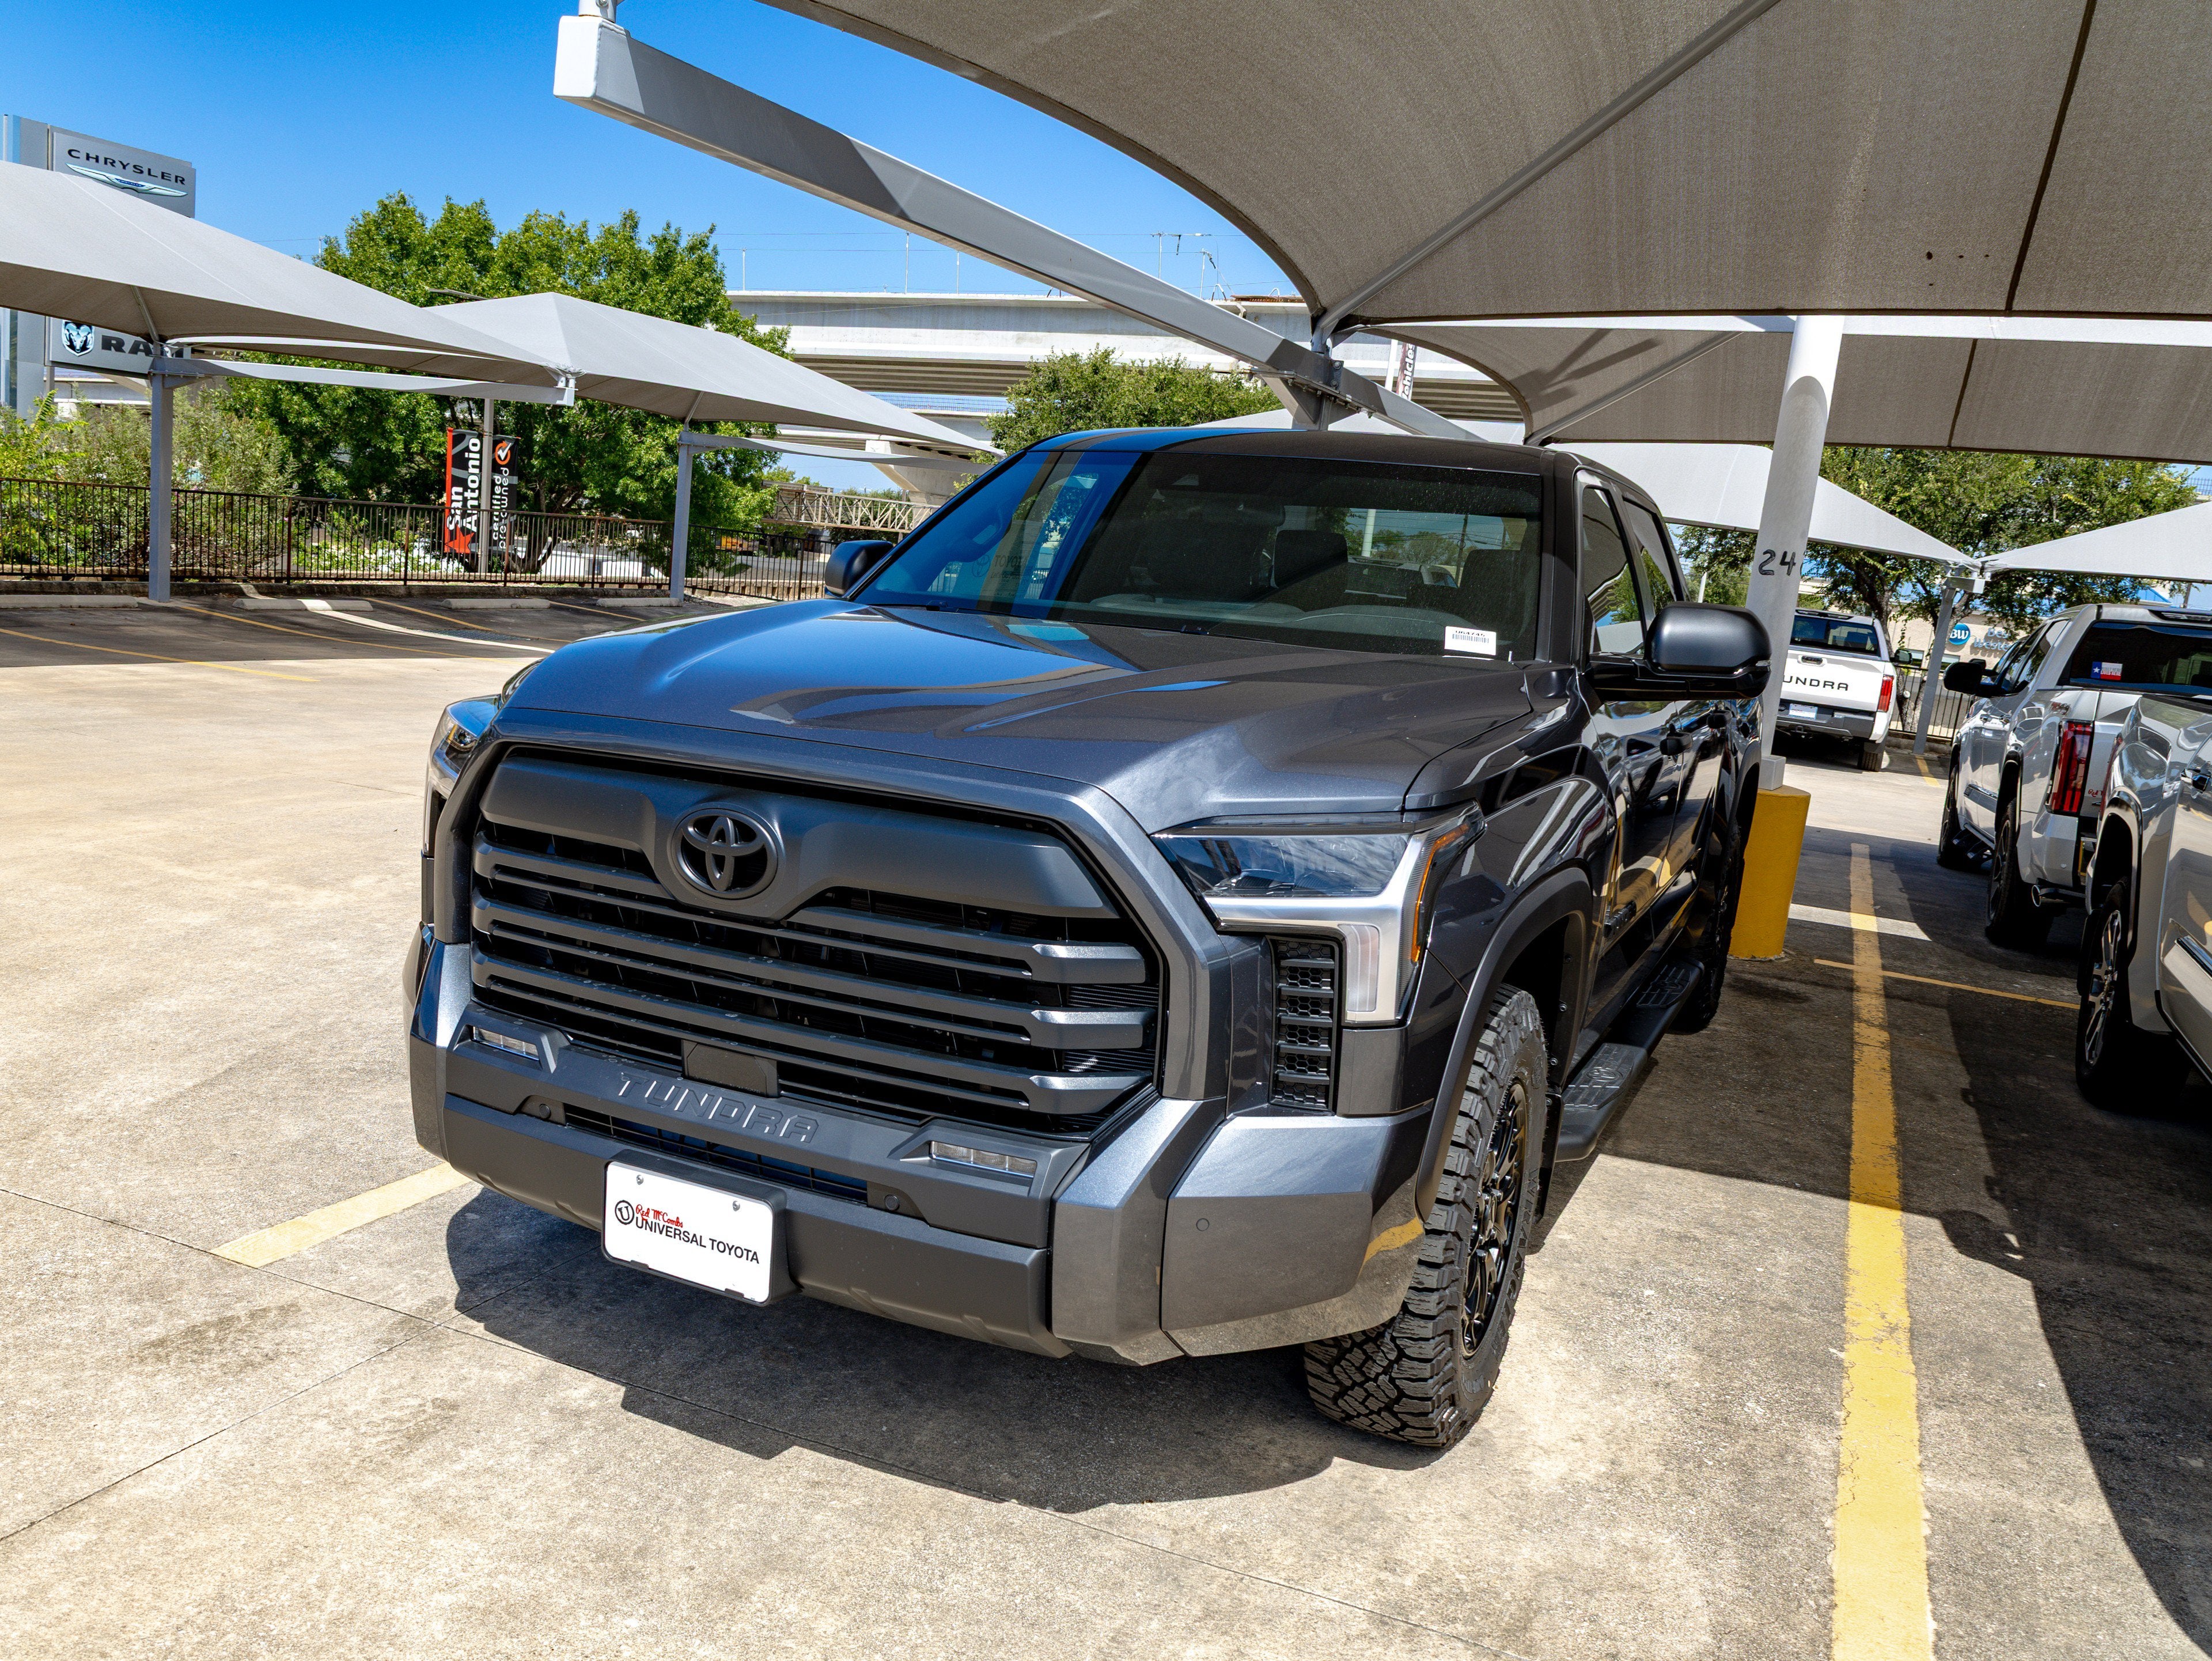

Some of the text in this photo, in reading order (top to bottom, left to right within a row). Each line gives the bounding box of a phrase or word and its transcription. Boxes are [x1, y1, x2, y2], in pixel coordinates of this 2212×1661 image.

[67, 149, 186, 186] CHRYSLER
[101, 335, 184, 358] RA
[463, 438, 480, 532] Antonio
[446, 487, 463, 530] San
[492, 475, 502, 540] certified
[499, 467, 509, 549] pre-owned
[1758, 549, 1806, 576] 24
[1950, 629, 1969, 640] BW
[1974, 637, 2010, 651] Weste
[1987, 627, 2011, 638] Bes
[1783, 675, 1849, 691] UNDRA
[619, 1072, 819, 1143] TUNDRA
[635, 1204, 683, 1228] Red McCombs
[635, 1216, 760, 1264] UNIVERSAL TOYOTA
